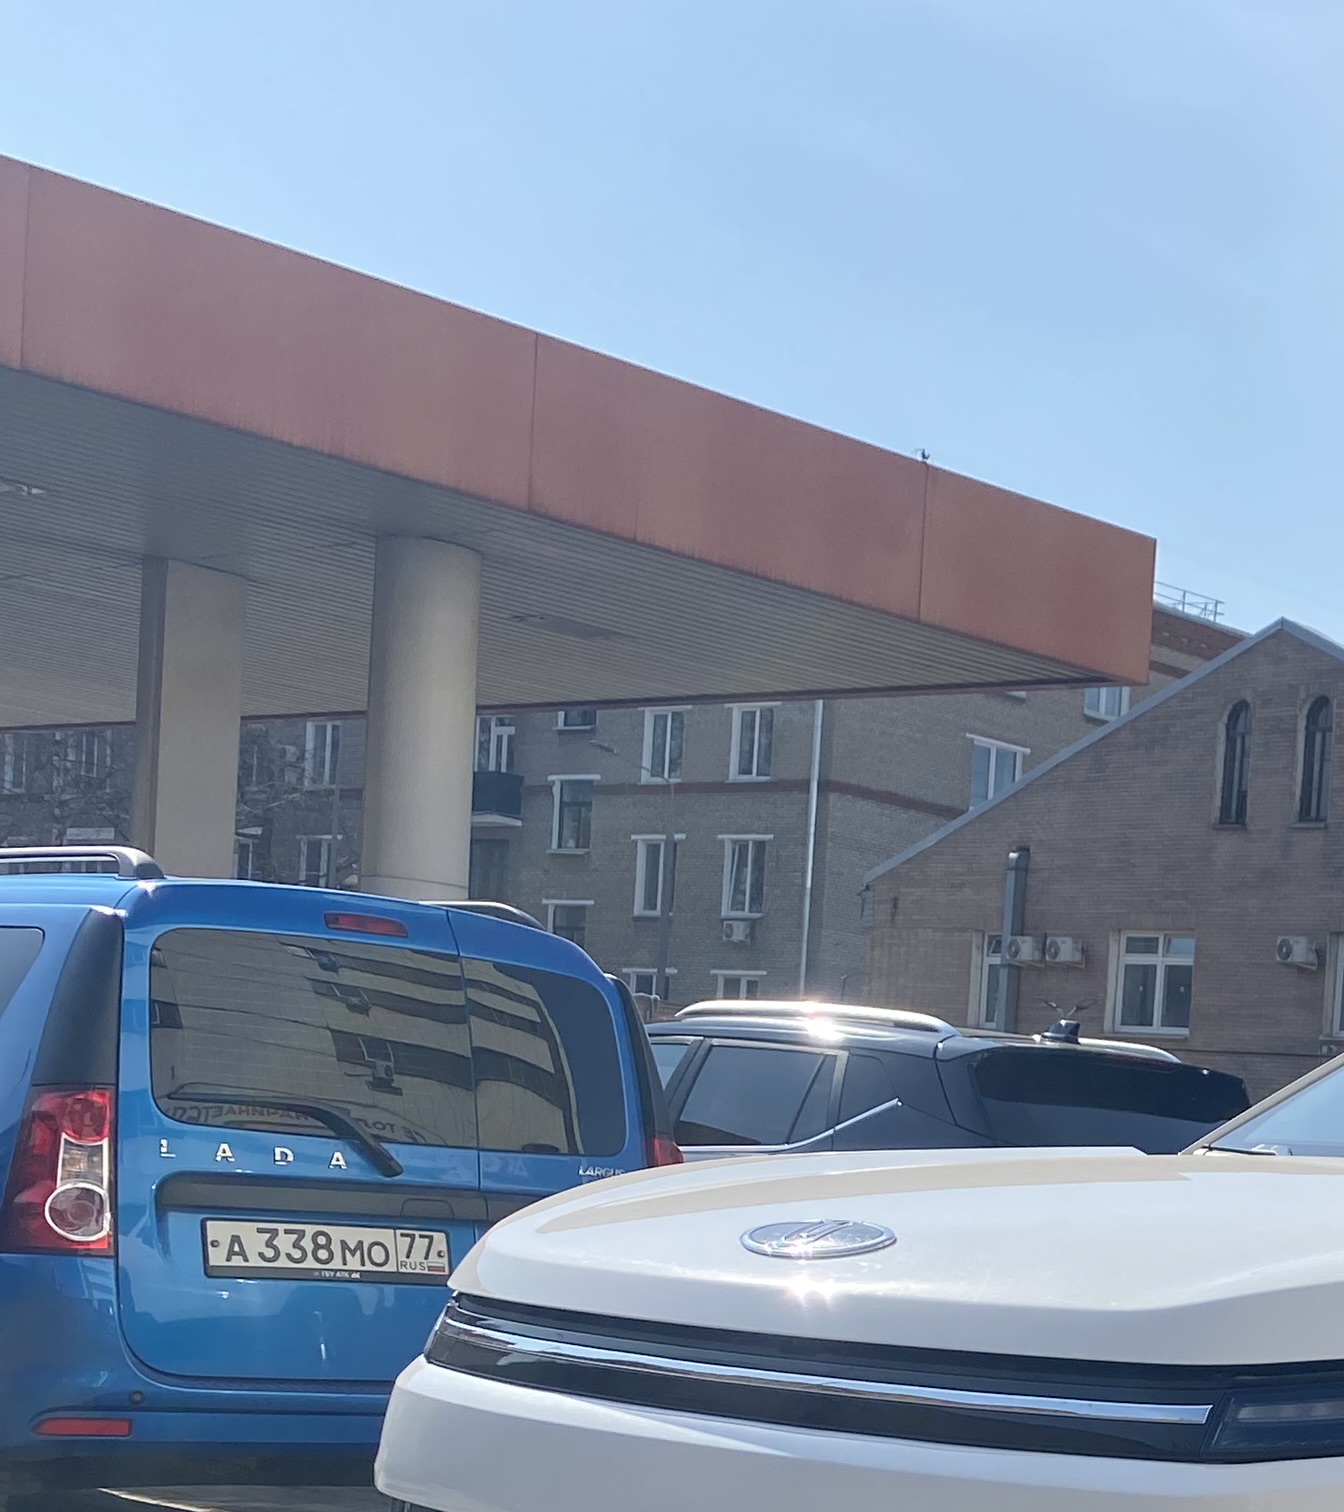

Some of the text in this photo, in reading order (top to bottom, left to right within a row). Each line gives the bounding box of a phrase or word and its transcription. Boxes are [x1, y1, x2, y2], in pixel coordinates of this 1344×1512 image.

[159, 1138, 348, 1169] LADA
[225, 1226, 434, 1268] А338МО 77
[400, 1260, 427, 1271] RUS
